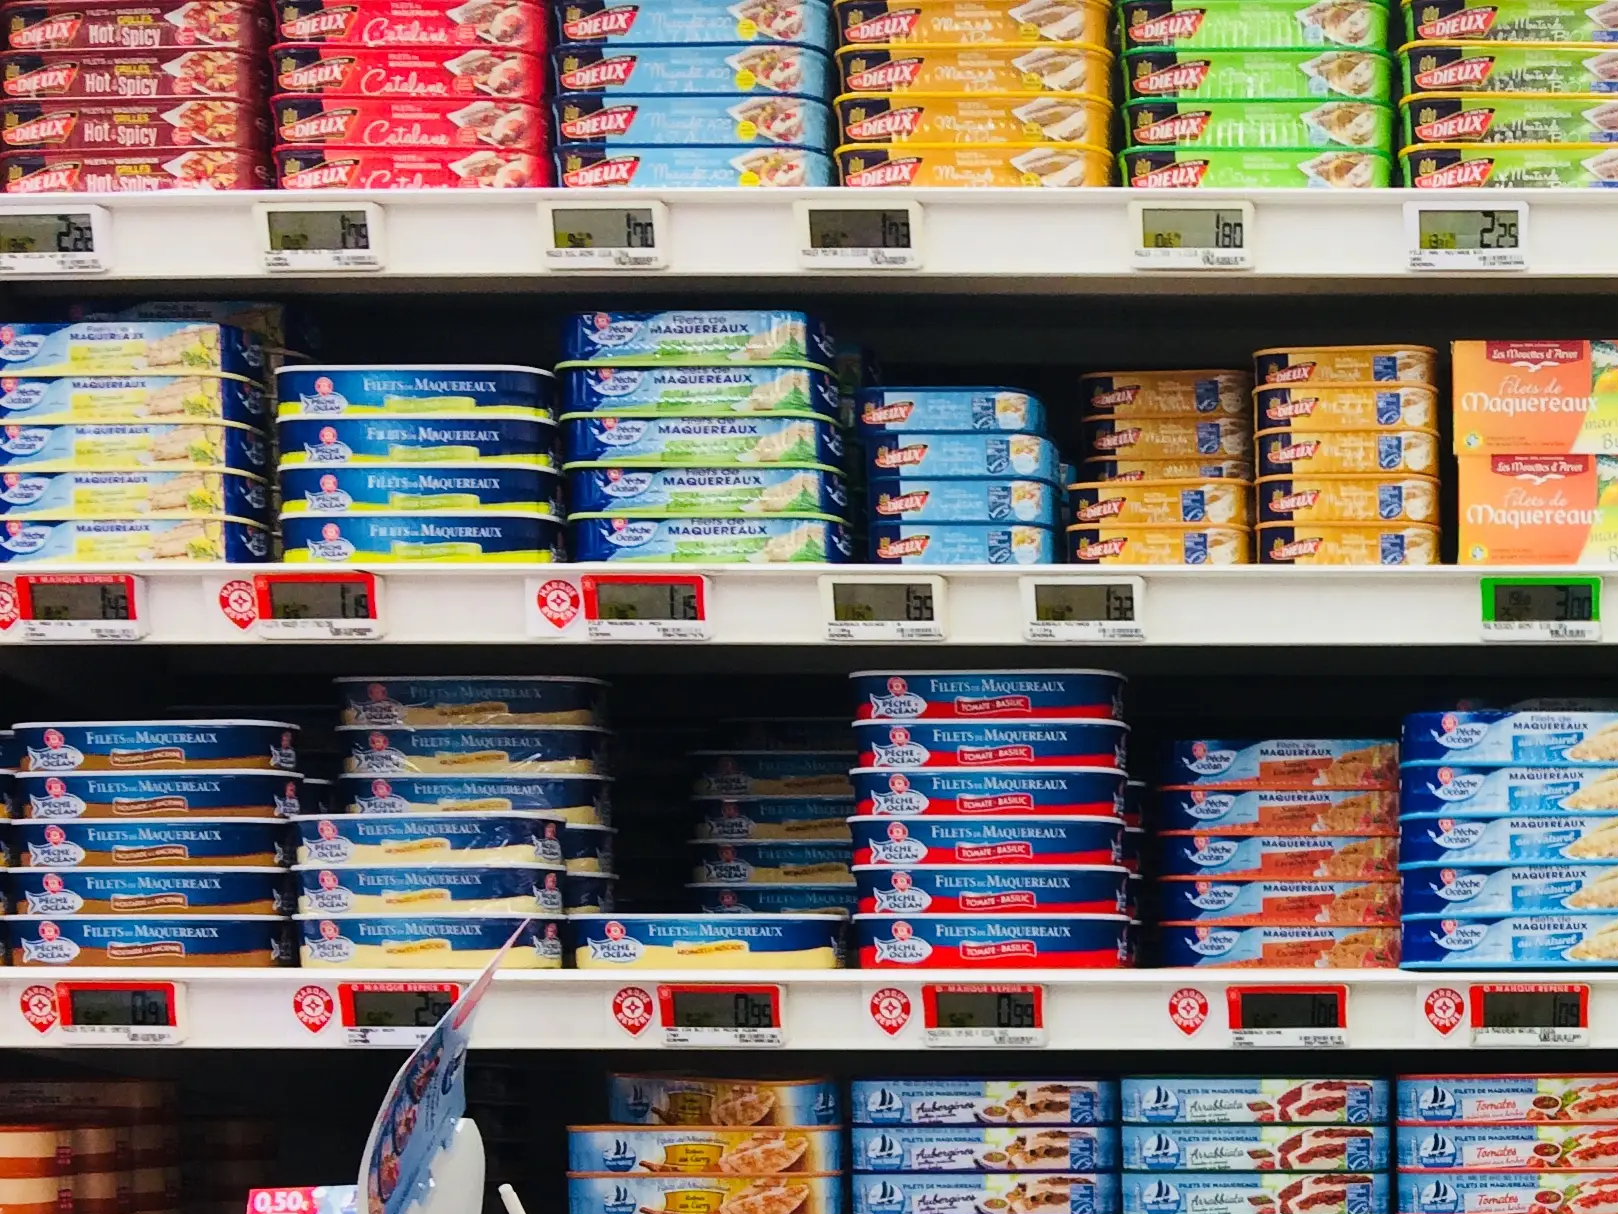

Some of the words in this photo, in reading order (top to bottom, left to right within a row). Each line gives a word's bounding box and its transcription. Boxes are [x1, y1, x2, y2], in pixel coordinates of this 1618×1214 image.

[21, 21, 70, 44] DIEUX
[869, 14, 912, 39] DIEUX
[1143, 14, 1197, 41] DIEUX
[88, 26, 112, 45] Hot
[121, 26, 161, 46] Spicy
[415, 378, 496, 393] MAQUEREAUX
[1499, 377, 1538, 396] Filets
[1461, 392, 1598, 415] Maquereaux
[662, 476, 762, 486] MAQUEREAUX
[1466, 504, 1604, 526] Maquereaux
[668, 525, 766, 536] MAQUEREAUX
[982, 679, 1065, 693] MAQUEREAUX
[137, 732, 217, 744] MAQUEREAUX
[1513, 922, 1588, 931] MAQUEREAUX
[917, 1102, 975, 1115] Aubergines
